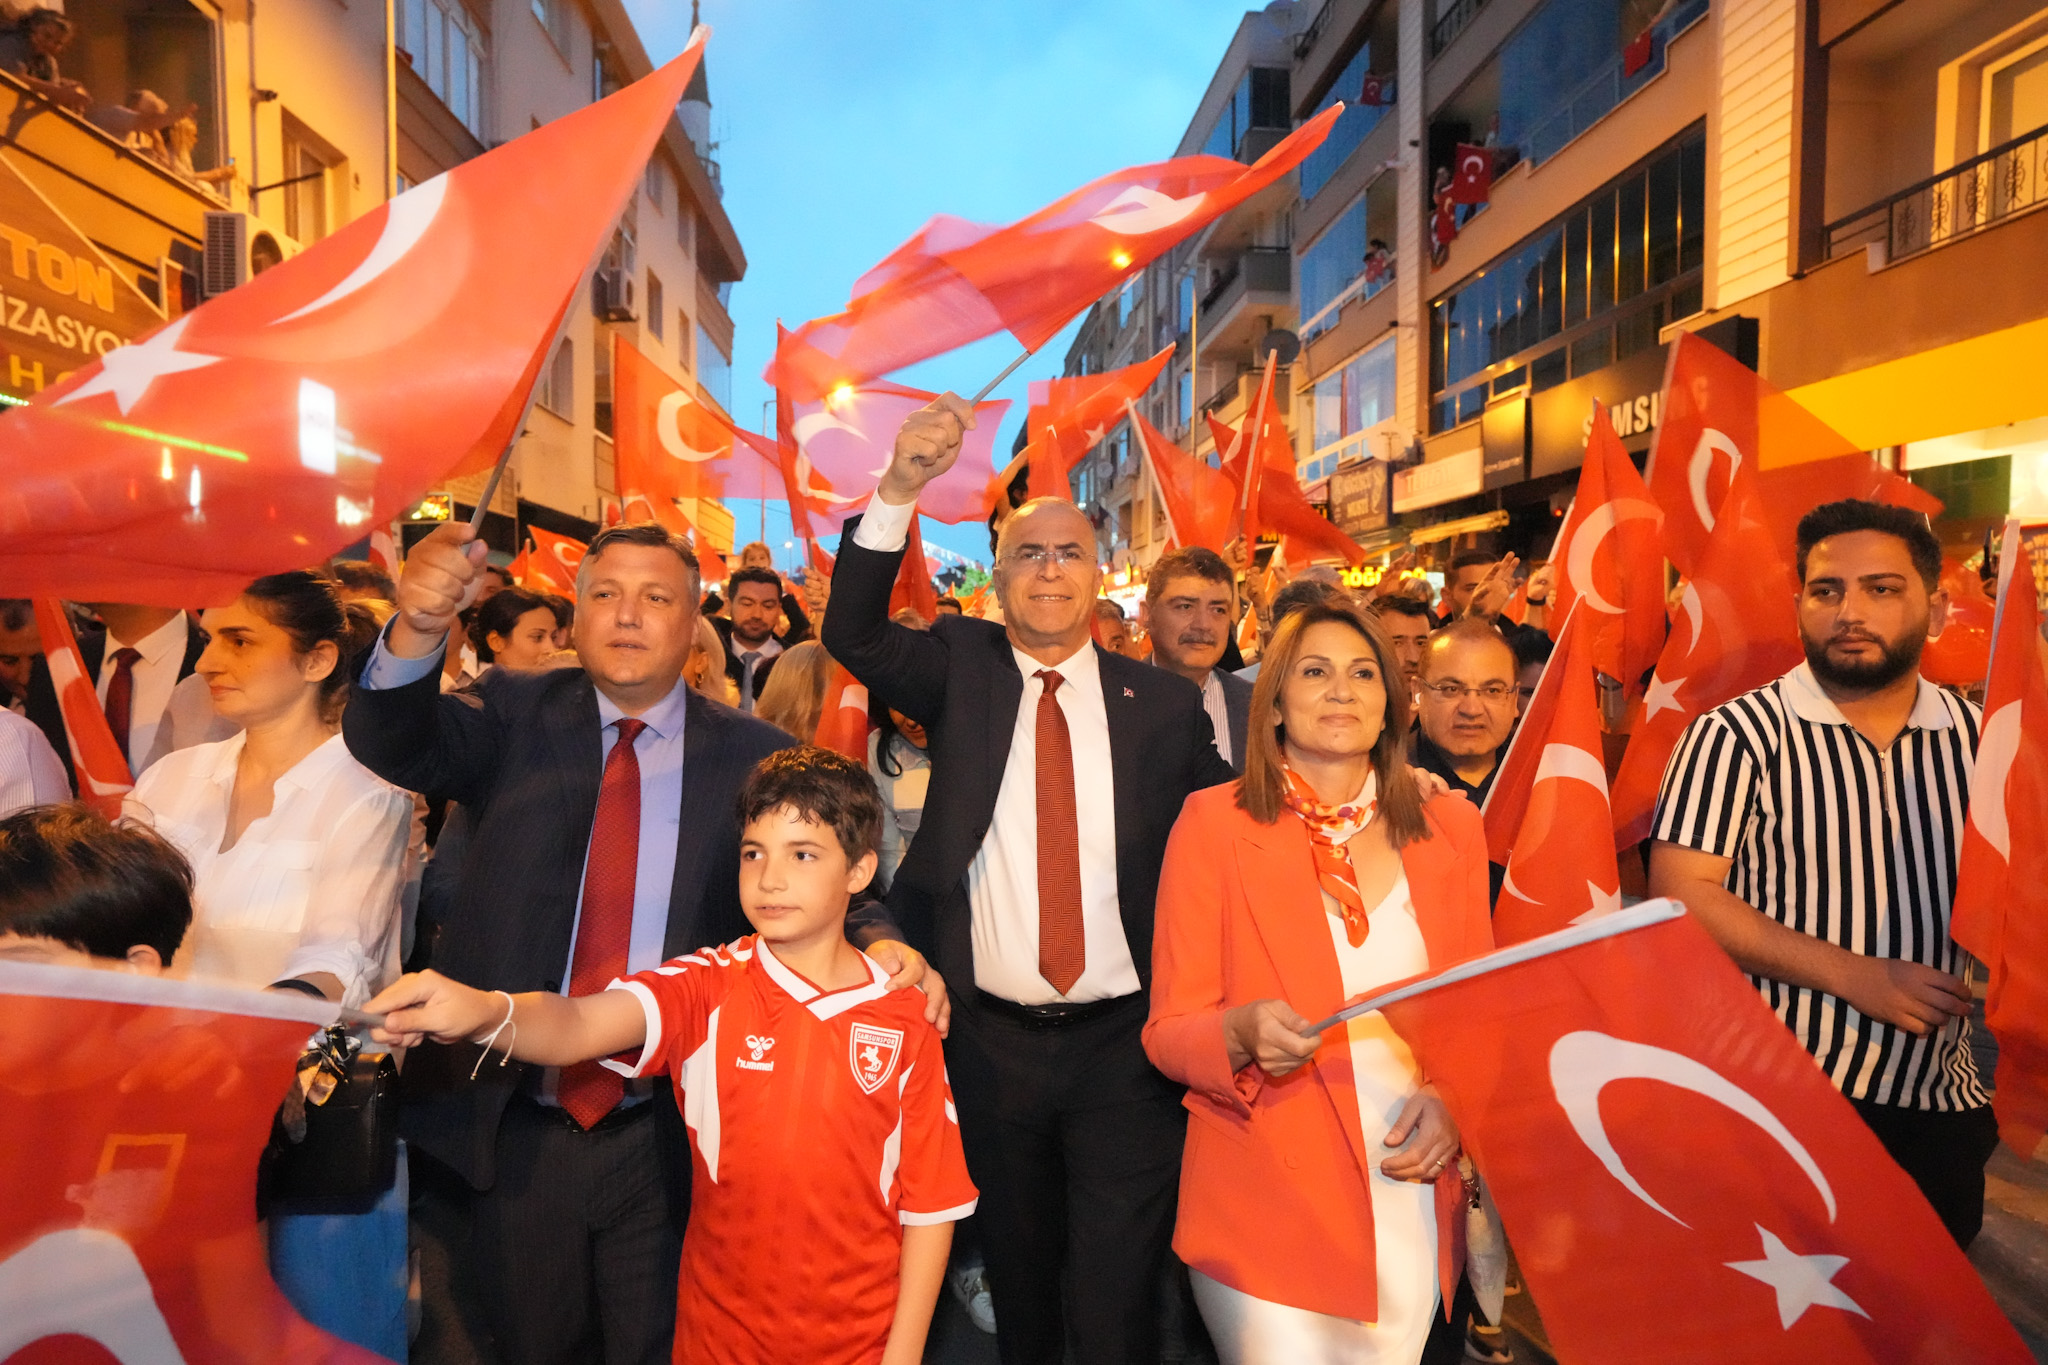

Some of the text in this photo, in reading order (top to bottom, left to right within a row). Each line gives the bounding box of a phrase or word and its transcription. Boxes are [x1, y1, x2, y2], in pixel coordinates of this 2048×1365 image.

[0, 284, 131, 357] İZASYO
[857, 1031, 896, 1046] SAMSUNSPOR
[736, 1056, 774, 1071] hummel
[864, 1071, 878, 1082] 1965
